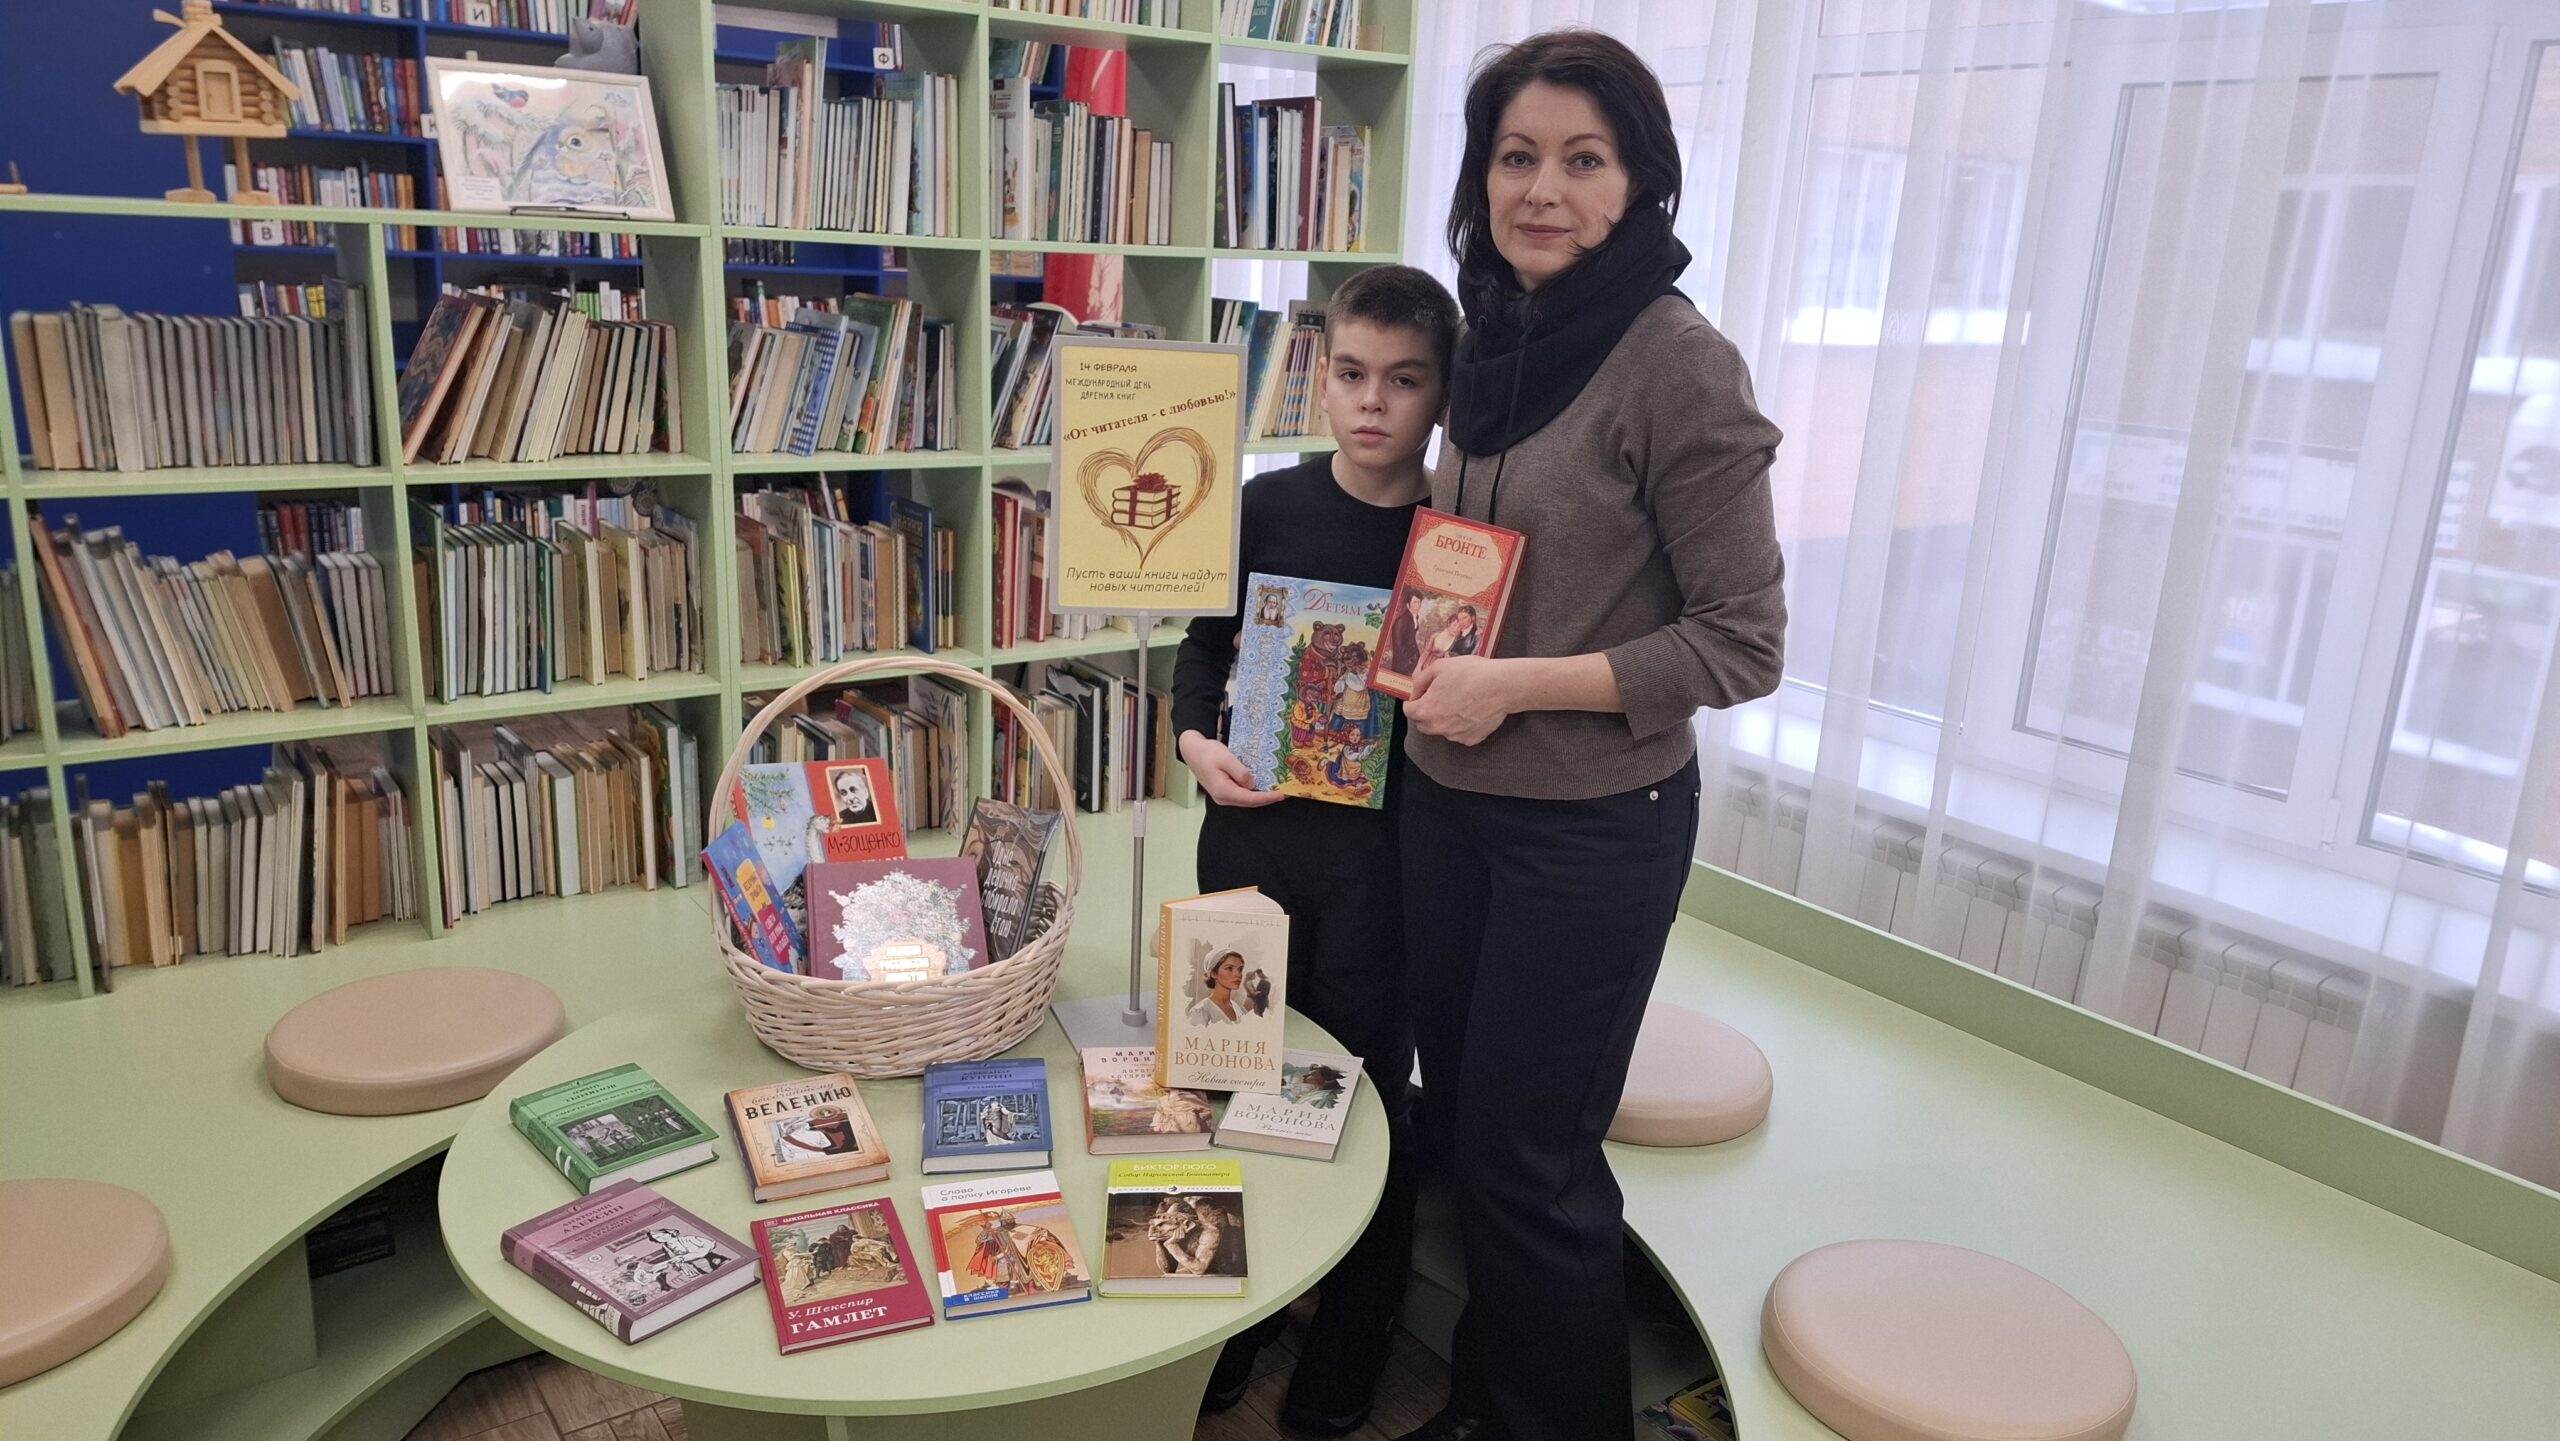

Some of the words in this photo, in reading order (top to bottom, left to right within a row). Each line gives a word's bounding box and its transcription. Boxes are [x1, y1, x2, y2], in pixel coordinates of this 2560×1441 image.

[473, 7, 486, 22] И
[878, 53, 890, 65] Ф
[261, 226, 272, 241] В
[1079, 362, 1091, 371] 14
[1093, 363, 1137, 373] ФЕВРАЛЯ
[1065, 378, 1131, 389] МЕЖДУНАРОДНЫЙ
[1133, 380, 1152, 390] ДЕНЬ
[1080, 391, 1115, 400] ДАРЕНИЯ
[1116, 392, 1137, 401] КНИГ
[1063, 427, 1089, 442] «От
[1090, 411, 1149, 435] читателя
[1159, 407, 1167, 417] с
[1169, 389, 1237, 415] любовью!»
[1434, 535, 1488, 559] БРОНТЕ
[1066, 567, 1106, 582] Пусть
[1108, 569, 1141, 580] ваши
[1144, 571, 1178, 581] книги
[1181, 570, 1228, 583] найдут
[1089, 582, 1127, 593] новых
[1129, 582, 1205, 594] читателей!
[1184, 1037, 1266, 1053] МАРИЯ
[1174, 1051, 1276, 1071] ВОРОНОВА
[1187, 1071, 1228, 1086] Новая
[1229, 1078, 1266, 1091] сестра
[745, 1086, 852, 1120] ВЕЛЕНИЮ
[1233, 1110, 1337, 1132] ВОРОНОВА
[1246, 1103, 1329, 1122] МАРИЯ
[1133, 1163, 1180, 1171] ВИКТОР
[939, 1187, 974, 1197] Слово
[950, 1191, 985, 1202] полку
[985, 1184, 1033, 1196] Игореве
[563, 1205, 625, 1234] АЛЕКСИН
[782, 1211, 833, 1223] ШКОЛЬНАЯ
[834, 1202, 880, 1213] КЛАССИКА
[806, 1297, 874, 1316] Шекспир
[789, 1305, 889, 1335] ГАМЛЕТ
